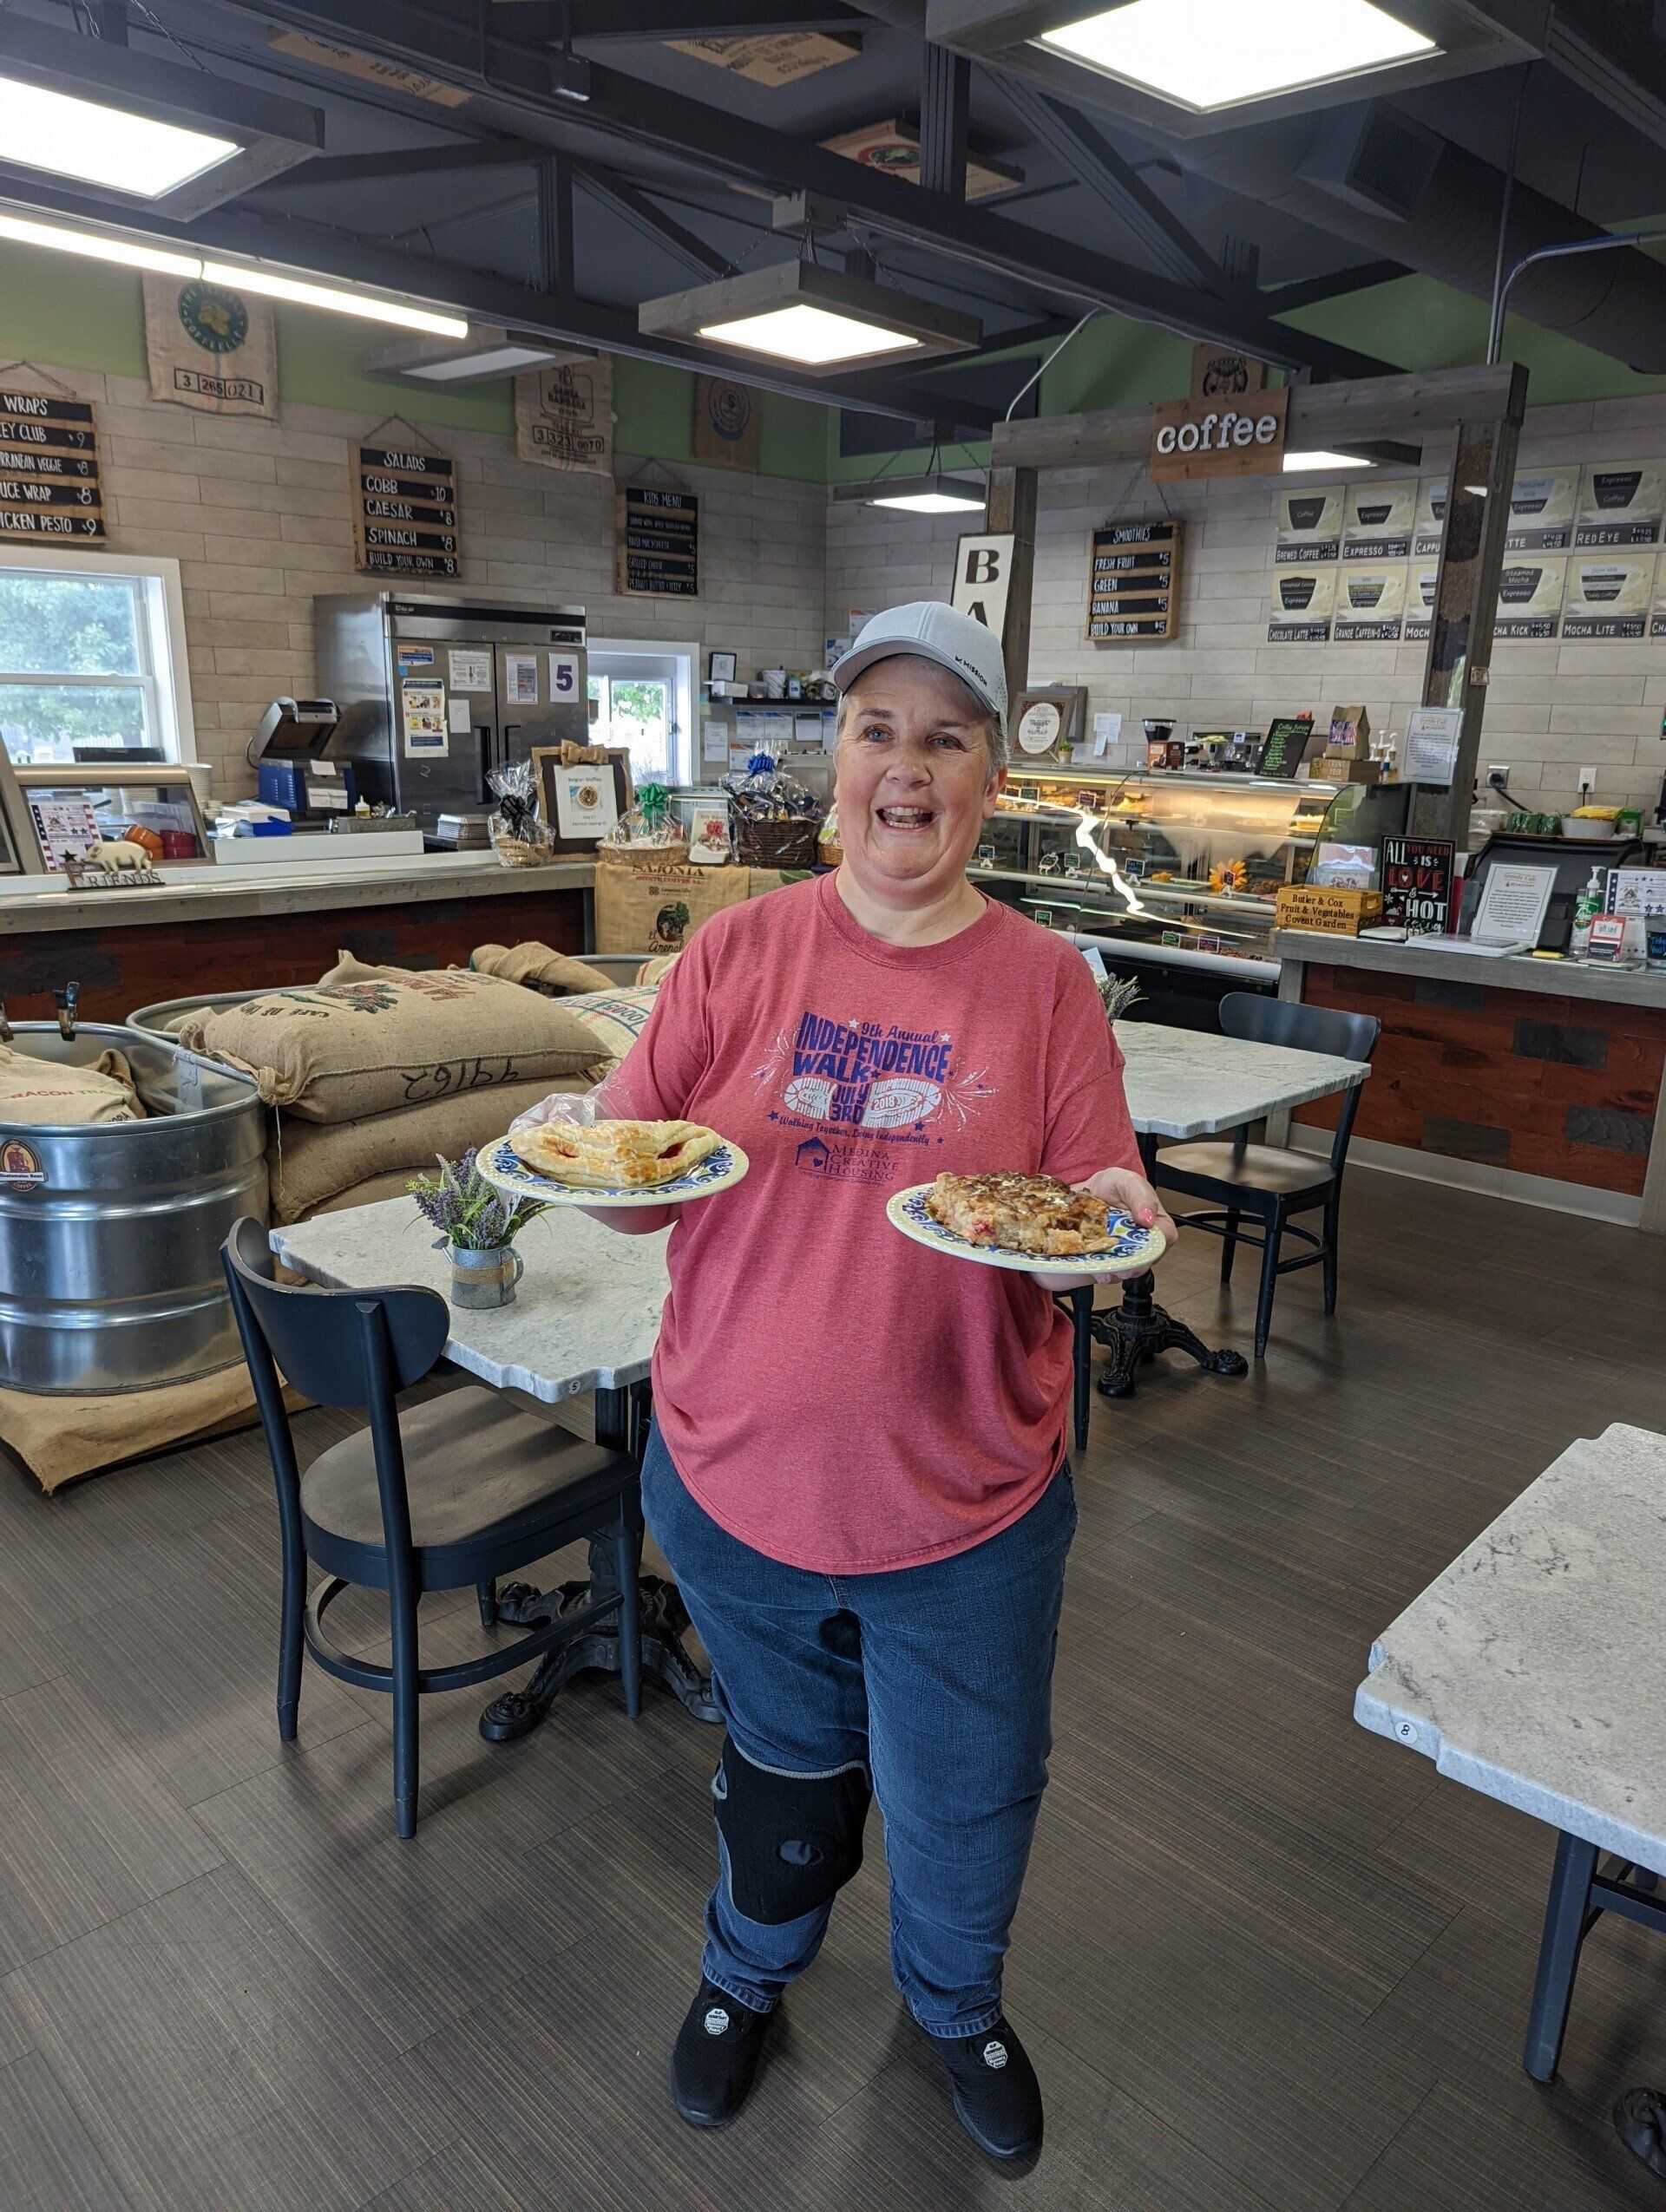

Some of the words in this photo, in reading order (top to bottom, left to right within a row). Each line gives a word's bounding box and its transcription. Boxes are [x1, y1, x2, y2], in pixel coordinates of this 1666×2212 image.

[183, 375, 191, 387] 3
[201, 379, 225, 392] 265
[3, 395, 49, 416] WRAPS
[0, 422, 16, 440] EY
[19, 423, 48, 443] CLUB
[537, 429, 545, 441] 3
[548, 433, 572, 448] 323
[1157, 412, 1277, 454] coffee
[36, 456, 62, 473] VEGGIE
[384, 452, 426, 472] SALADS
[23, 484, 52, 502] WRAP
[366, 476, 398, 494] COBB
[644, 491, 659, 505] KIDS
[662, 494, 682, 508] MENU
[366, 501, 413, 520] CAESAR
[40, 515, 72, 533] PESTO
[369, 527, 417, 546] SPINACH
[441, 536, 453, 553] $8
[1113, 527, 1151, 544] SMOOTHIES
[1276, 550, 1296, 561] BREWED
[1299, 549, 1319, 560] COFFEE
[1343, 546, 1383, 558] EXPRESSO
[369, 552, 392, 566] BUILD
[397, 555, 414, 567] YOUR
[416, 557, 434, 569] OWN
[444, 559, 455, 573] $8
[1094, 558, 1115, 572] FRESH
[1118, 556, 1136, 569] FRUIT
[1159, 553, 1170, 566] $5
[1094, 578, 1118, 592] GREEN
[1158, 574, 1169, 588] $5
[1092, 600, 1118, 615] BANANA
[1158, 598, 1168, 612] $5
[1090, 622, 1109, 637] BUILD
[1110, 622, 1125, 635] YOUR
[1125, 623, 1138, 634] OWN
[1155, 621, 1166, 634] $5
[1269, 628, 1293, 641] CHOCOLATE
[1294, 628, 1309, 640] LATTE
[1335, 627, 1354, 639] GRANDE
[1510, 625, 1529, 636] KICK
[1564, 625, 1591, 636] MOCHA
[1596, 624, 1616, 635] LITE
[555, 664, 574, 692] 5
[963, 660, 988, 687] MISSION
[1387, 841, 1407, 866] ALL
[1407, 844, 1423, 855] YOU
[1427, 846, 1450, 856] NEED
[1420, 856, 1432, 867] IS
[59, 862, 162, 888] FRIENDS
[633, 864, 705, 877] SAJONIA
[1387, 867, 1444, 892] LOVE
[1292, 894, 1316, 905] Butler
[1328, 898, 1343, 907] Cox
[1409, 887, 1417, 899] &
[1281, 903, 1300, 914] Fruit
[1302, 906, 1309, 914] &
[1312, 906, 1354, 919] Vegetables
[1406, 898, 1447, 921] HOT
[1285, 915, 1314, 926] Covent
[1317, 919, 1347, 929] Garden
[861, 1022, 883, 1037] 9th
[887, 1025, 940, 1044] Annual
[795, 1011, 954, 1083] INDEPENDENCE
[793, 1050, 871, 1083] WALK
[831, 1084, 870, 1105] JULY
[873, 1096, 896, 1111] 2018
[830, 1103, 865, 1125] 3RD
[780, 1116, 814, 1132] Walking
[816, 1122, 850, 1137] Together,
[876, 1129, 930, 1147] Independently
[832, 1143, 890, 1162] MEDINA
[830, 1154, 899, 1171] CREATIVE
[829, 1163, 895, 1181] HOUSING
[571, 1381, 580, 1391] 5
[1400, 1724, 1411, 1736] 8
